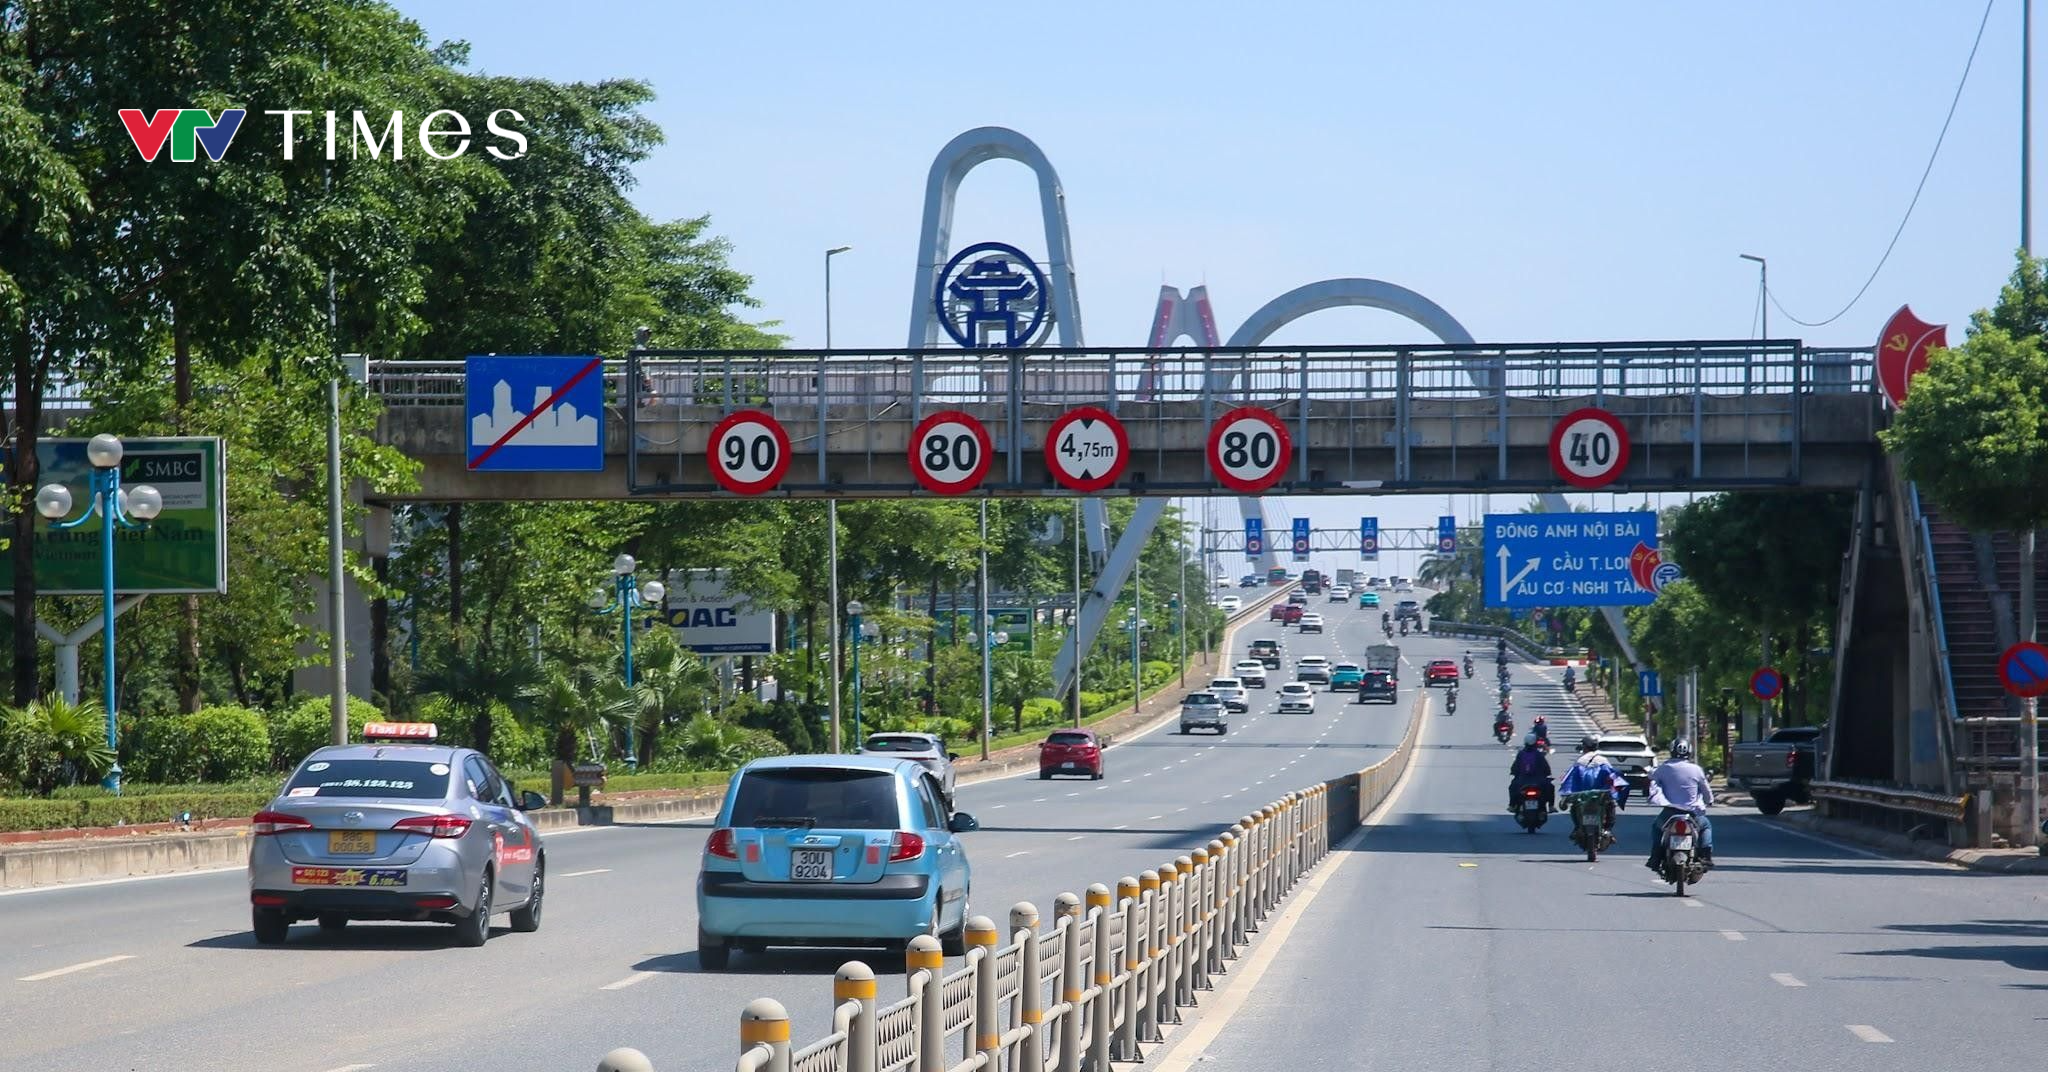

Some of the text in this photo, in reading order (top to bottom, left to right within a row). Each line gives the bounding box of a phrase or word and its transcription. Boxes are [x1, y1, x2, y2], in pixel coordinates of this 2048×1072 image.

[724, 434, 776, 472] 90
[924, 433, 978, 472] 80
[1060, 432, 1115, 462] 4,75m
[1223, 431, 1276, 469] 80
[1569, 432, 1611, 467] 40
[145, 460, 197, 477] SMBC
[1496, 520, 1640, 540] ĐÔNG ANH NỘI BÀI
[1552, 551, 1583, 571] CẦU
[370, 723, 430, 736] Taxi 123
[800, 851, 825, 865] 30U
[795, 865, 827, 878] 9204
